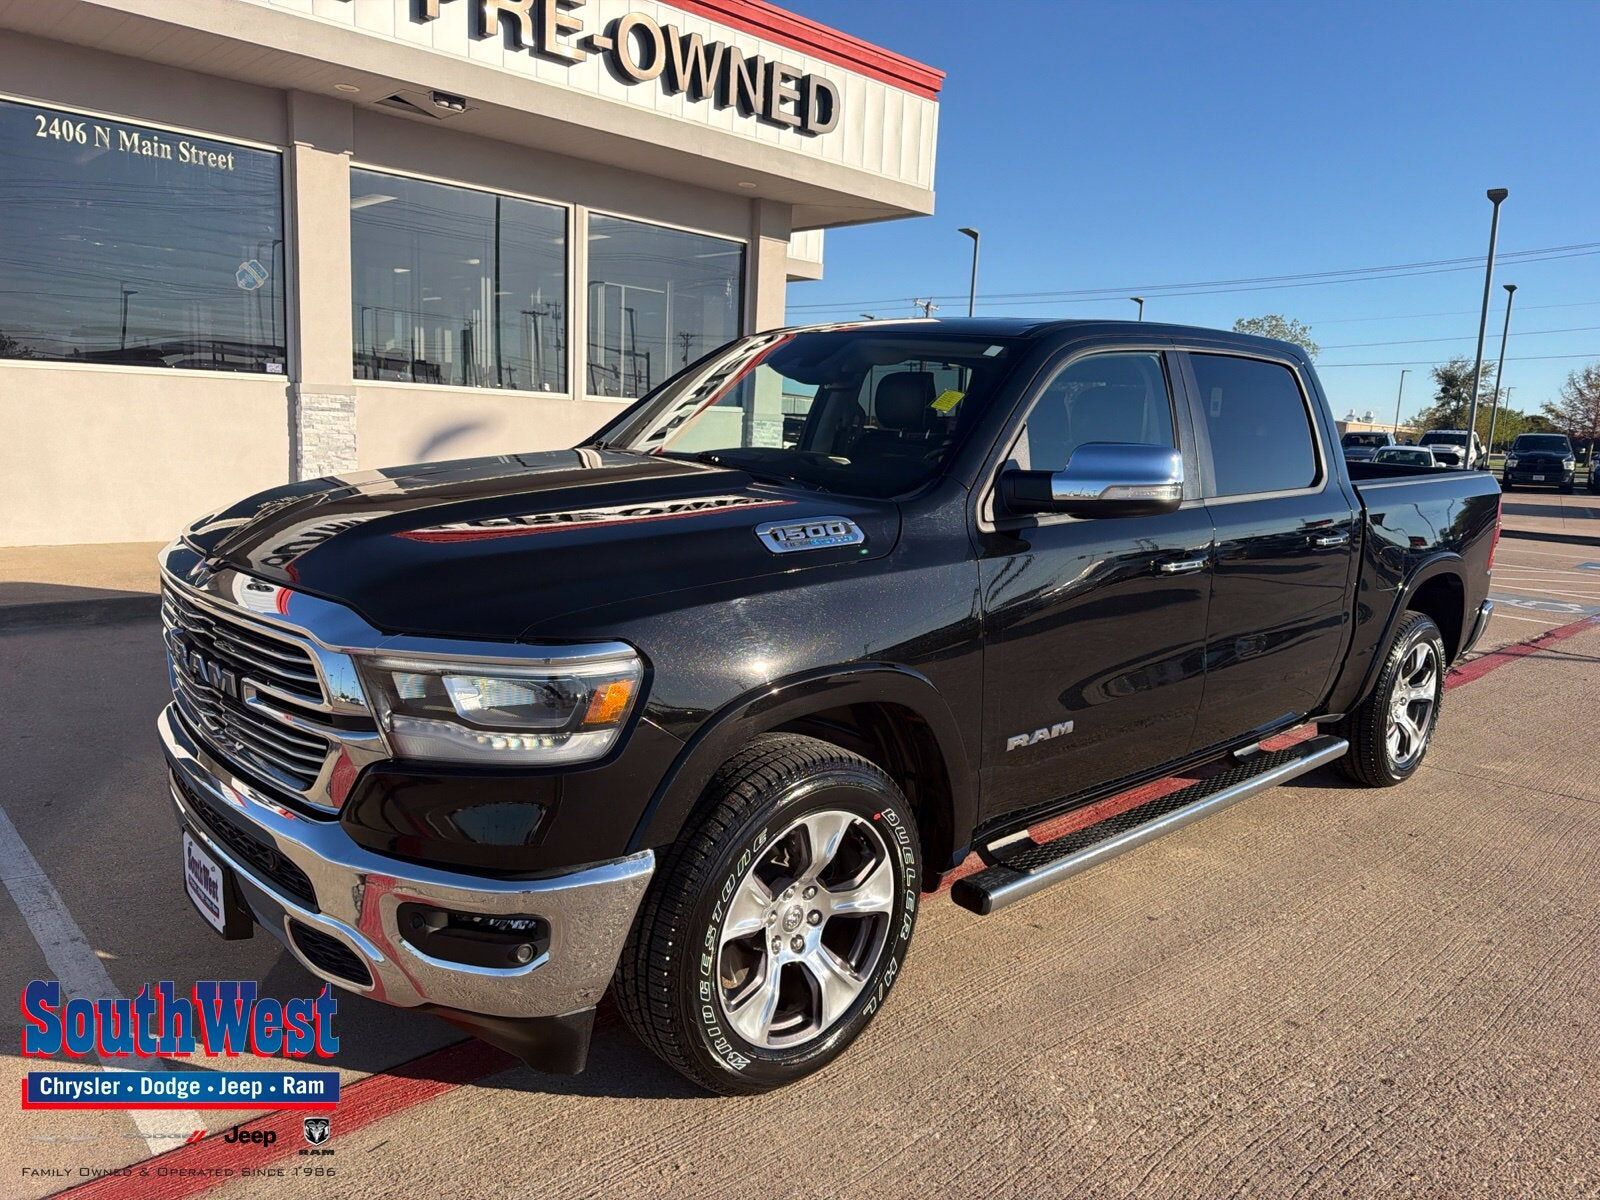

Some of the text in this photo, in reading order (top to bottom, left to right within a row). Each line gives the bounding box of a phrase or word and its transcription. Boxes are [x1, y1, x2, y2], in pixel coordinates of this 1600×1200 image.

[35, 114, 235, 171] 2406 N Main Street
[769, 521, 847, 541] 1500
[170, 627, 238, 698] RAM
[1005, 719, 1074, 752] RAM
[881, 808, 916, 941] DUELER
[699, 827, 767, 1071] BRIDGESTONE
